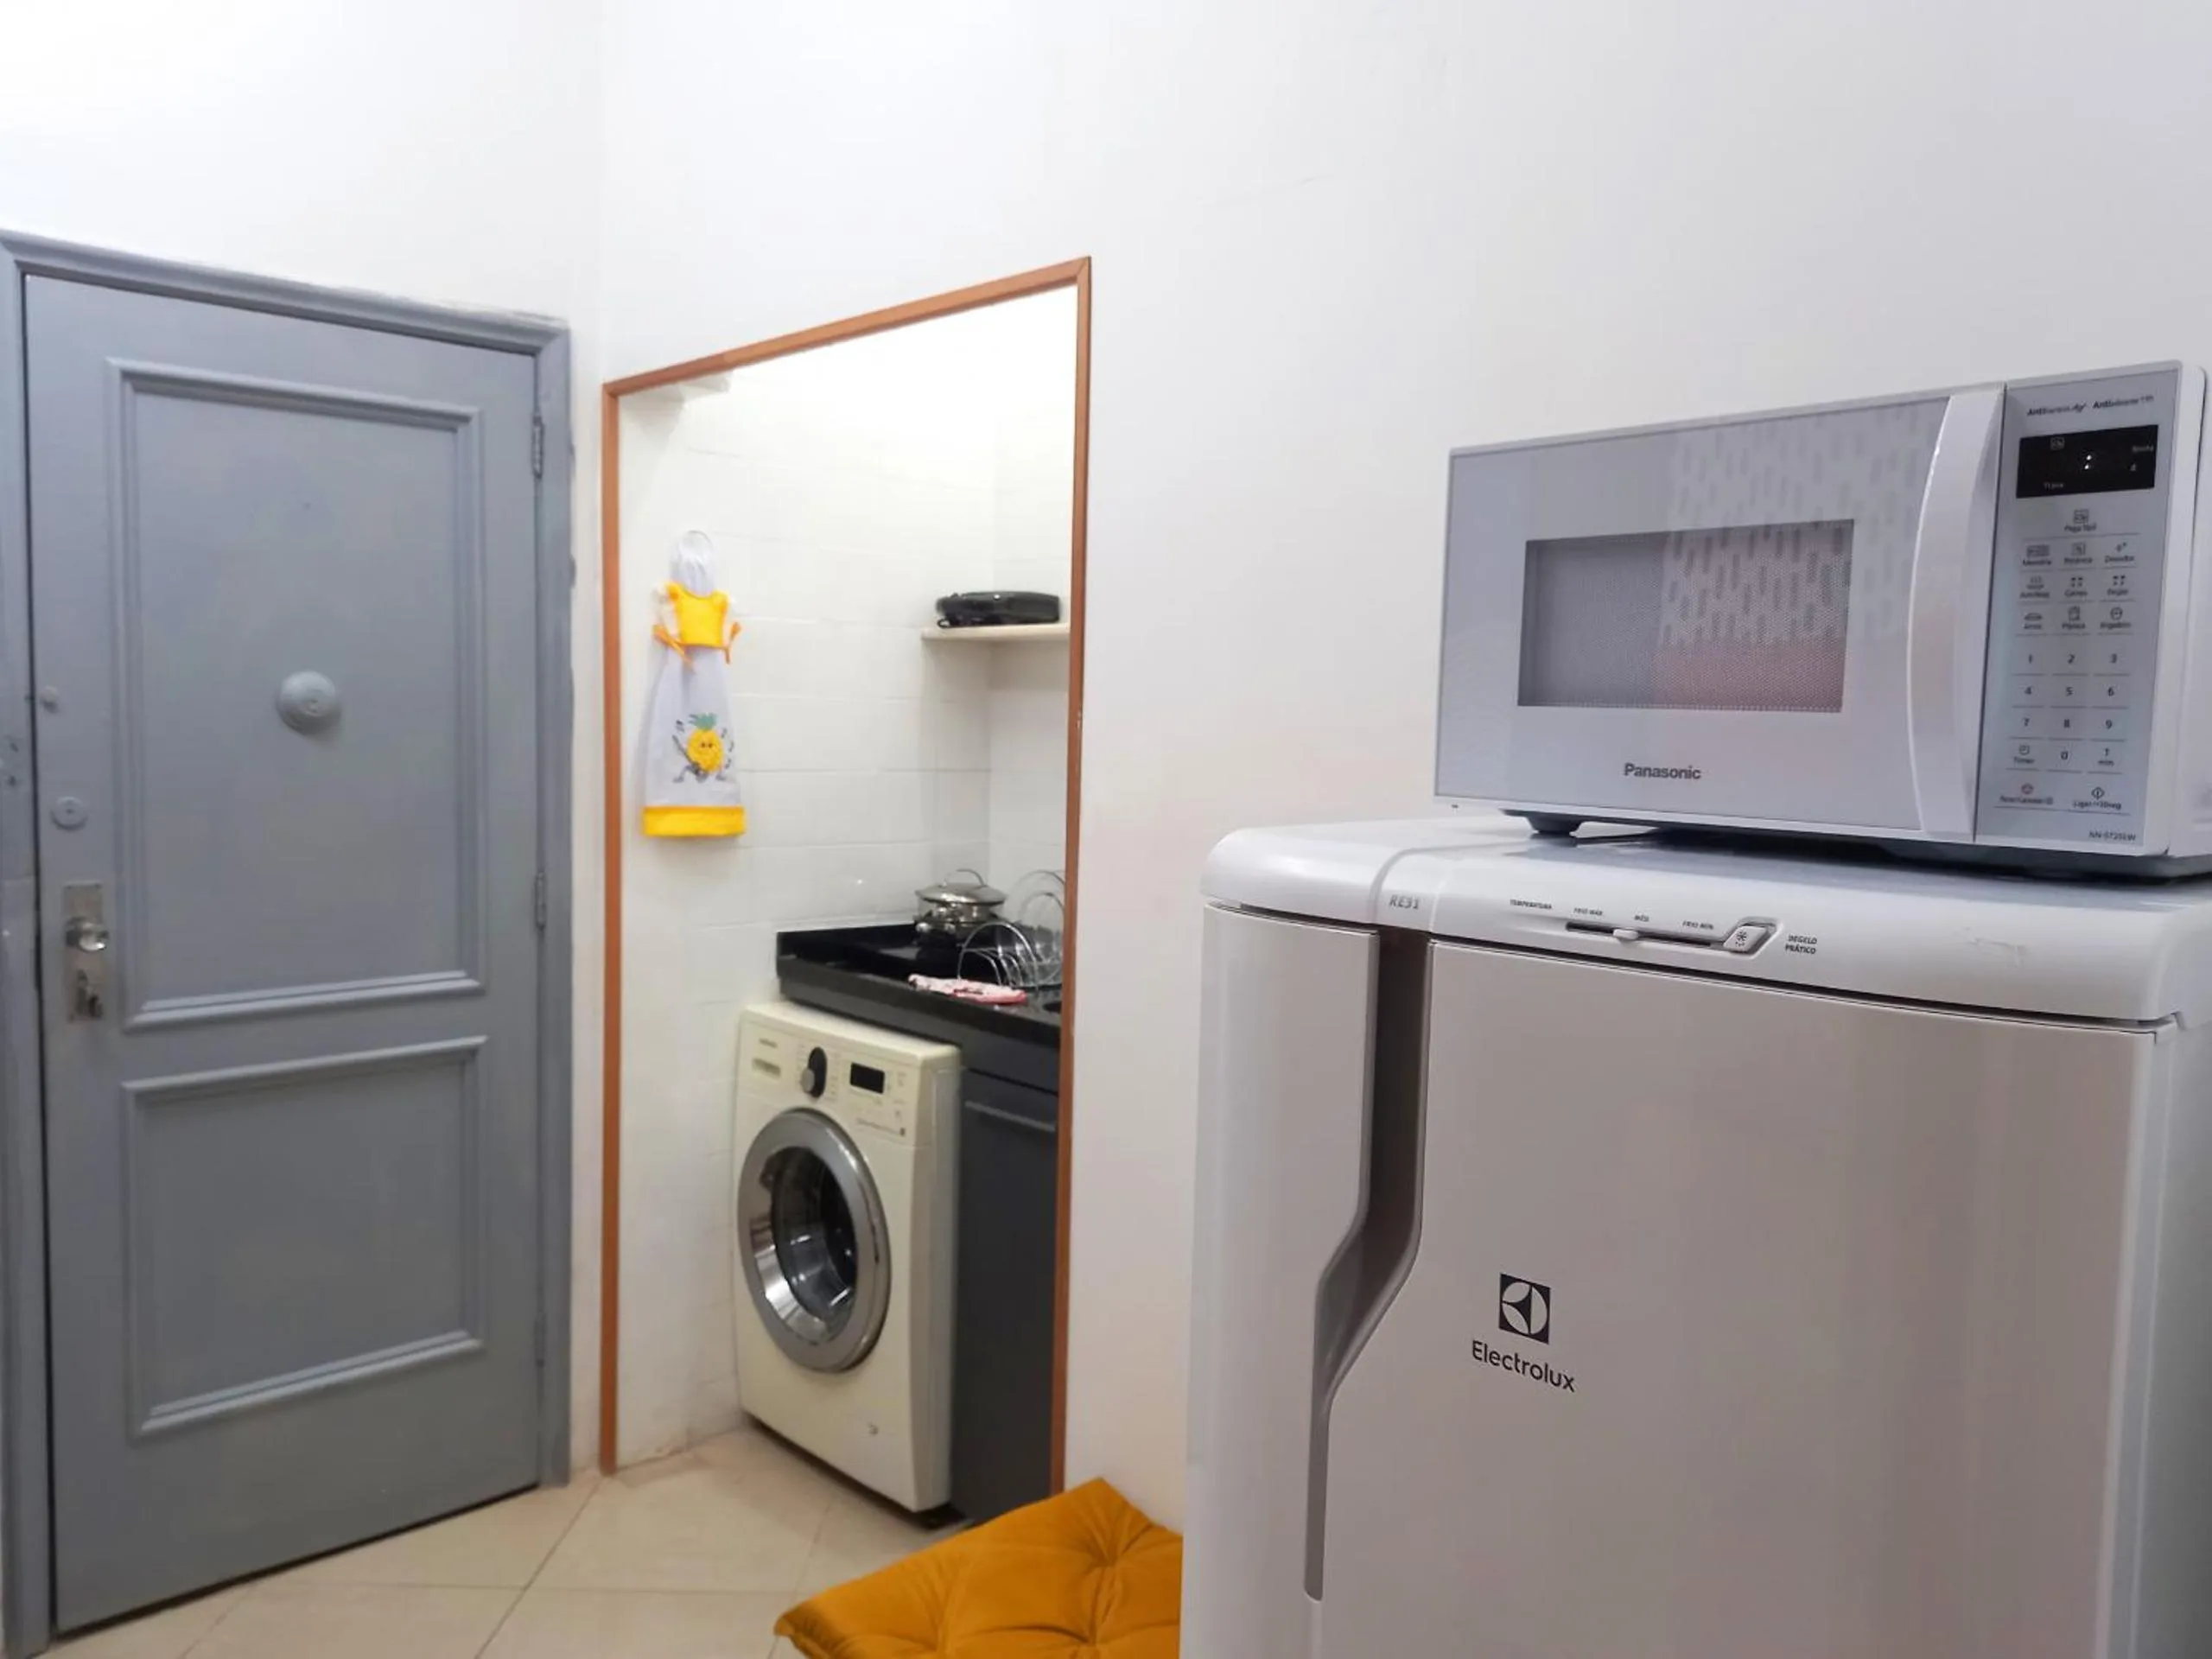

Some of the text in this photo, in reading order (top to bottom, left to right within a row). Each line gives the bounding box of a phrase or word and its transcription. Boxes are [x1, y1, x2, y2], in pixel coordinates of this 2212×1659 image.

[2067, 653, 2075, 664] 2
[2110, 653, 2118, 664] 3
[2024, 686, 2032, 695] 4
[2065, 686, 2074, 696] 5
[2107, 687, 2115, 697] 6
[2022, 717, 2031, 728] 7
[2063, 718, 2071, 728] 8
[2105, 719, 2113, 729] 9
[1624, 762, 1701, 779] Panasonic
[1788, 934, 1818, 944] DEGELO
[1785, 943, 1816, 955] PRÁTICO
[1472, 1340, 1575, 1393] Electrolux
